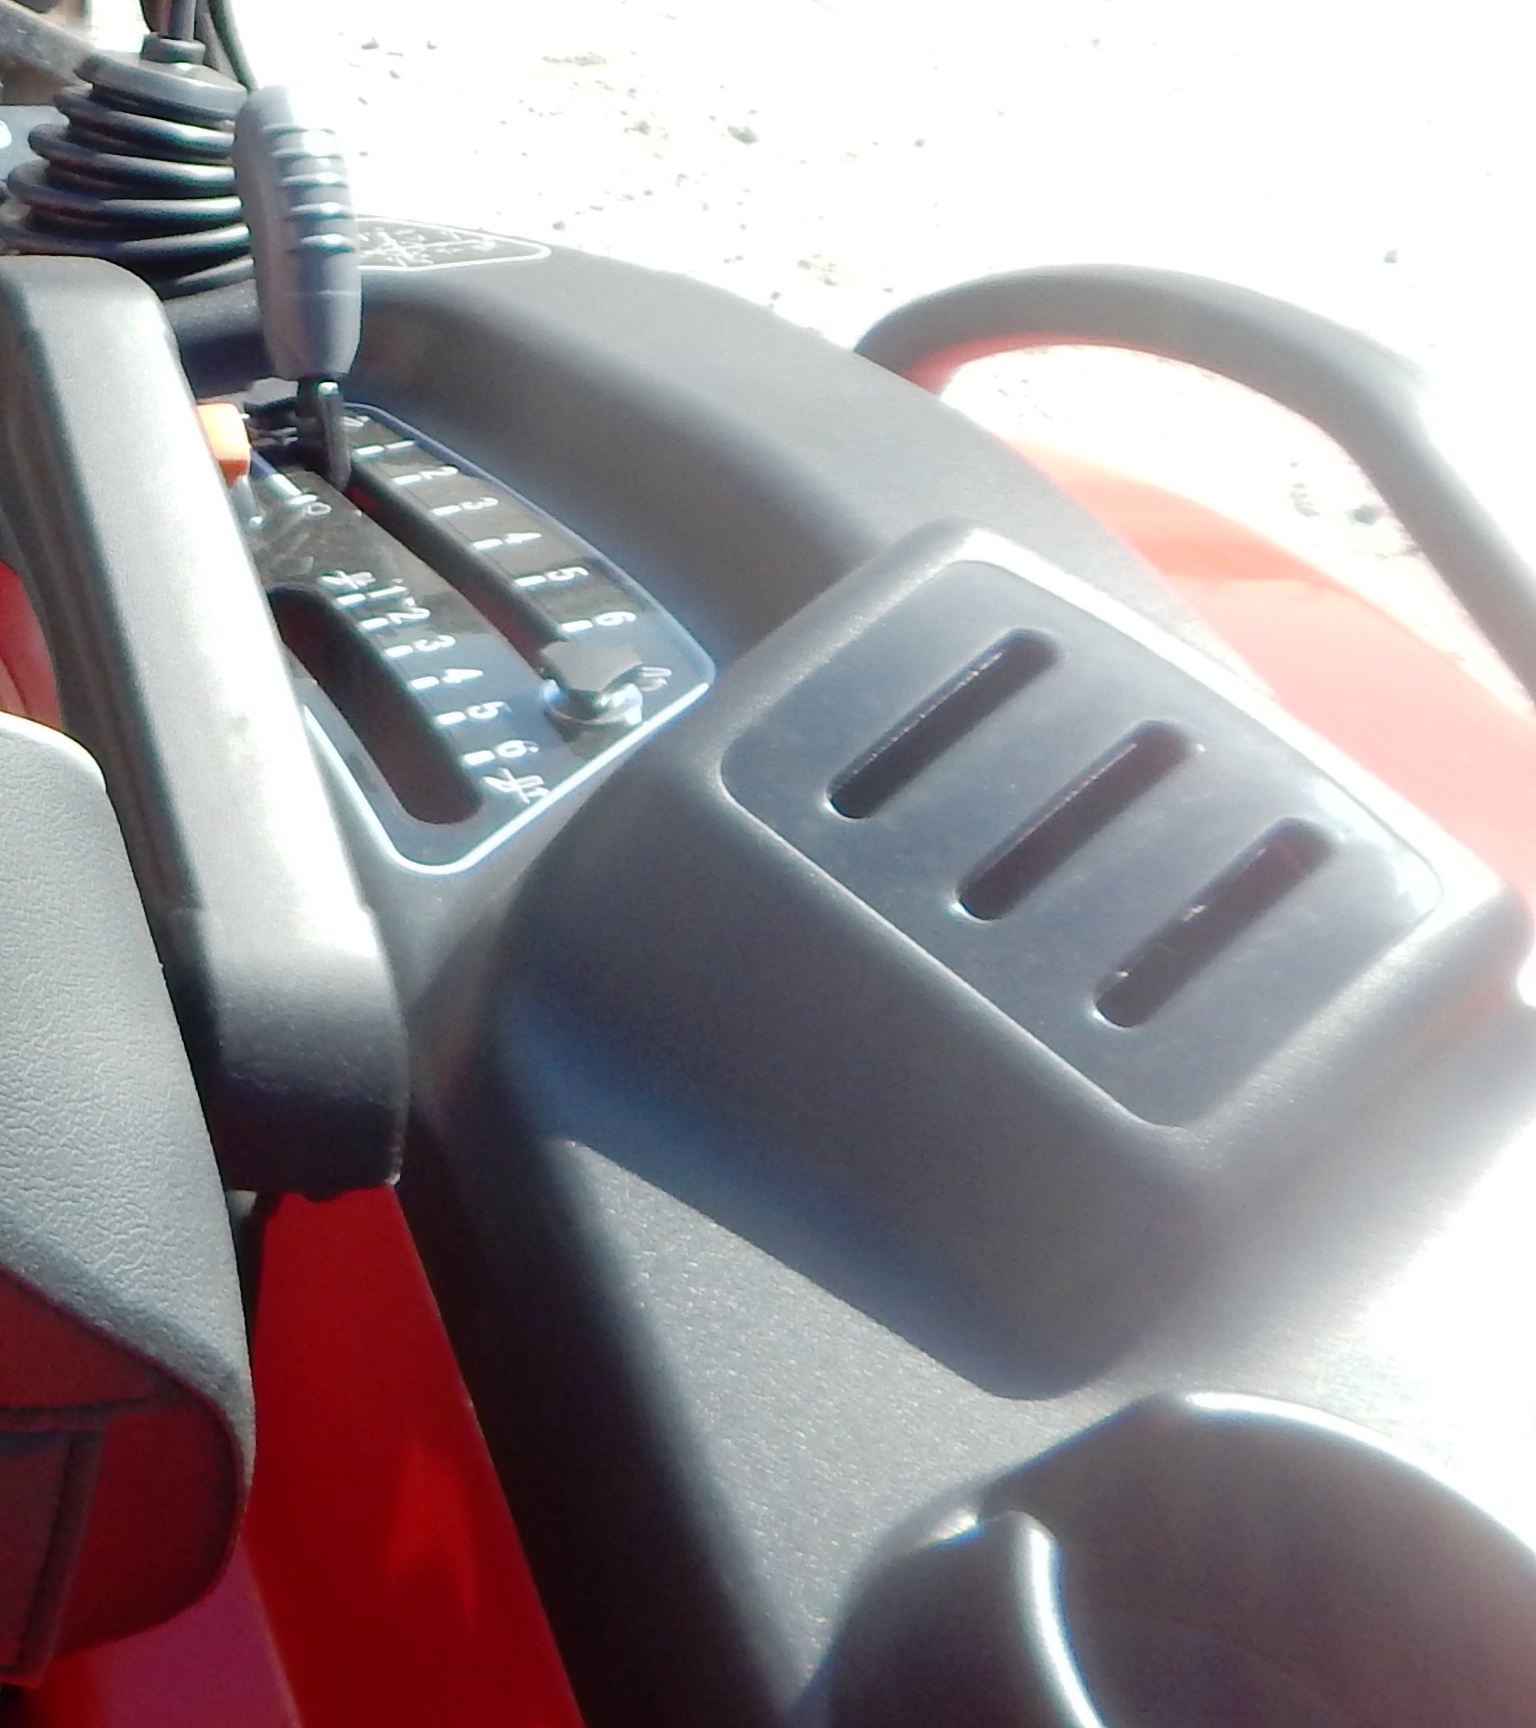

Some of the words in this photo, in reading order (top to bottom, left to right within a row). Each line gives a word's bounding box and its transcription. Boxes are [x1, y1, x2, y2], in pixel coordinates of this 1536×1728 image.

[420, 464, 460, 480] 2
[461, 497, 499, 512] 3
[505, 532, 542, 544] 4
[547, 566, 590, 583] 5
[389, 606, 431, 624] 2
[594, 610, 637, 627] 6
[413, 634, 456, 652] 3
[442, 668, 484, 684] 4
[466, 701, 512, 720] 5
[495, 738, 540, 758] 6
